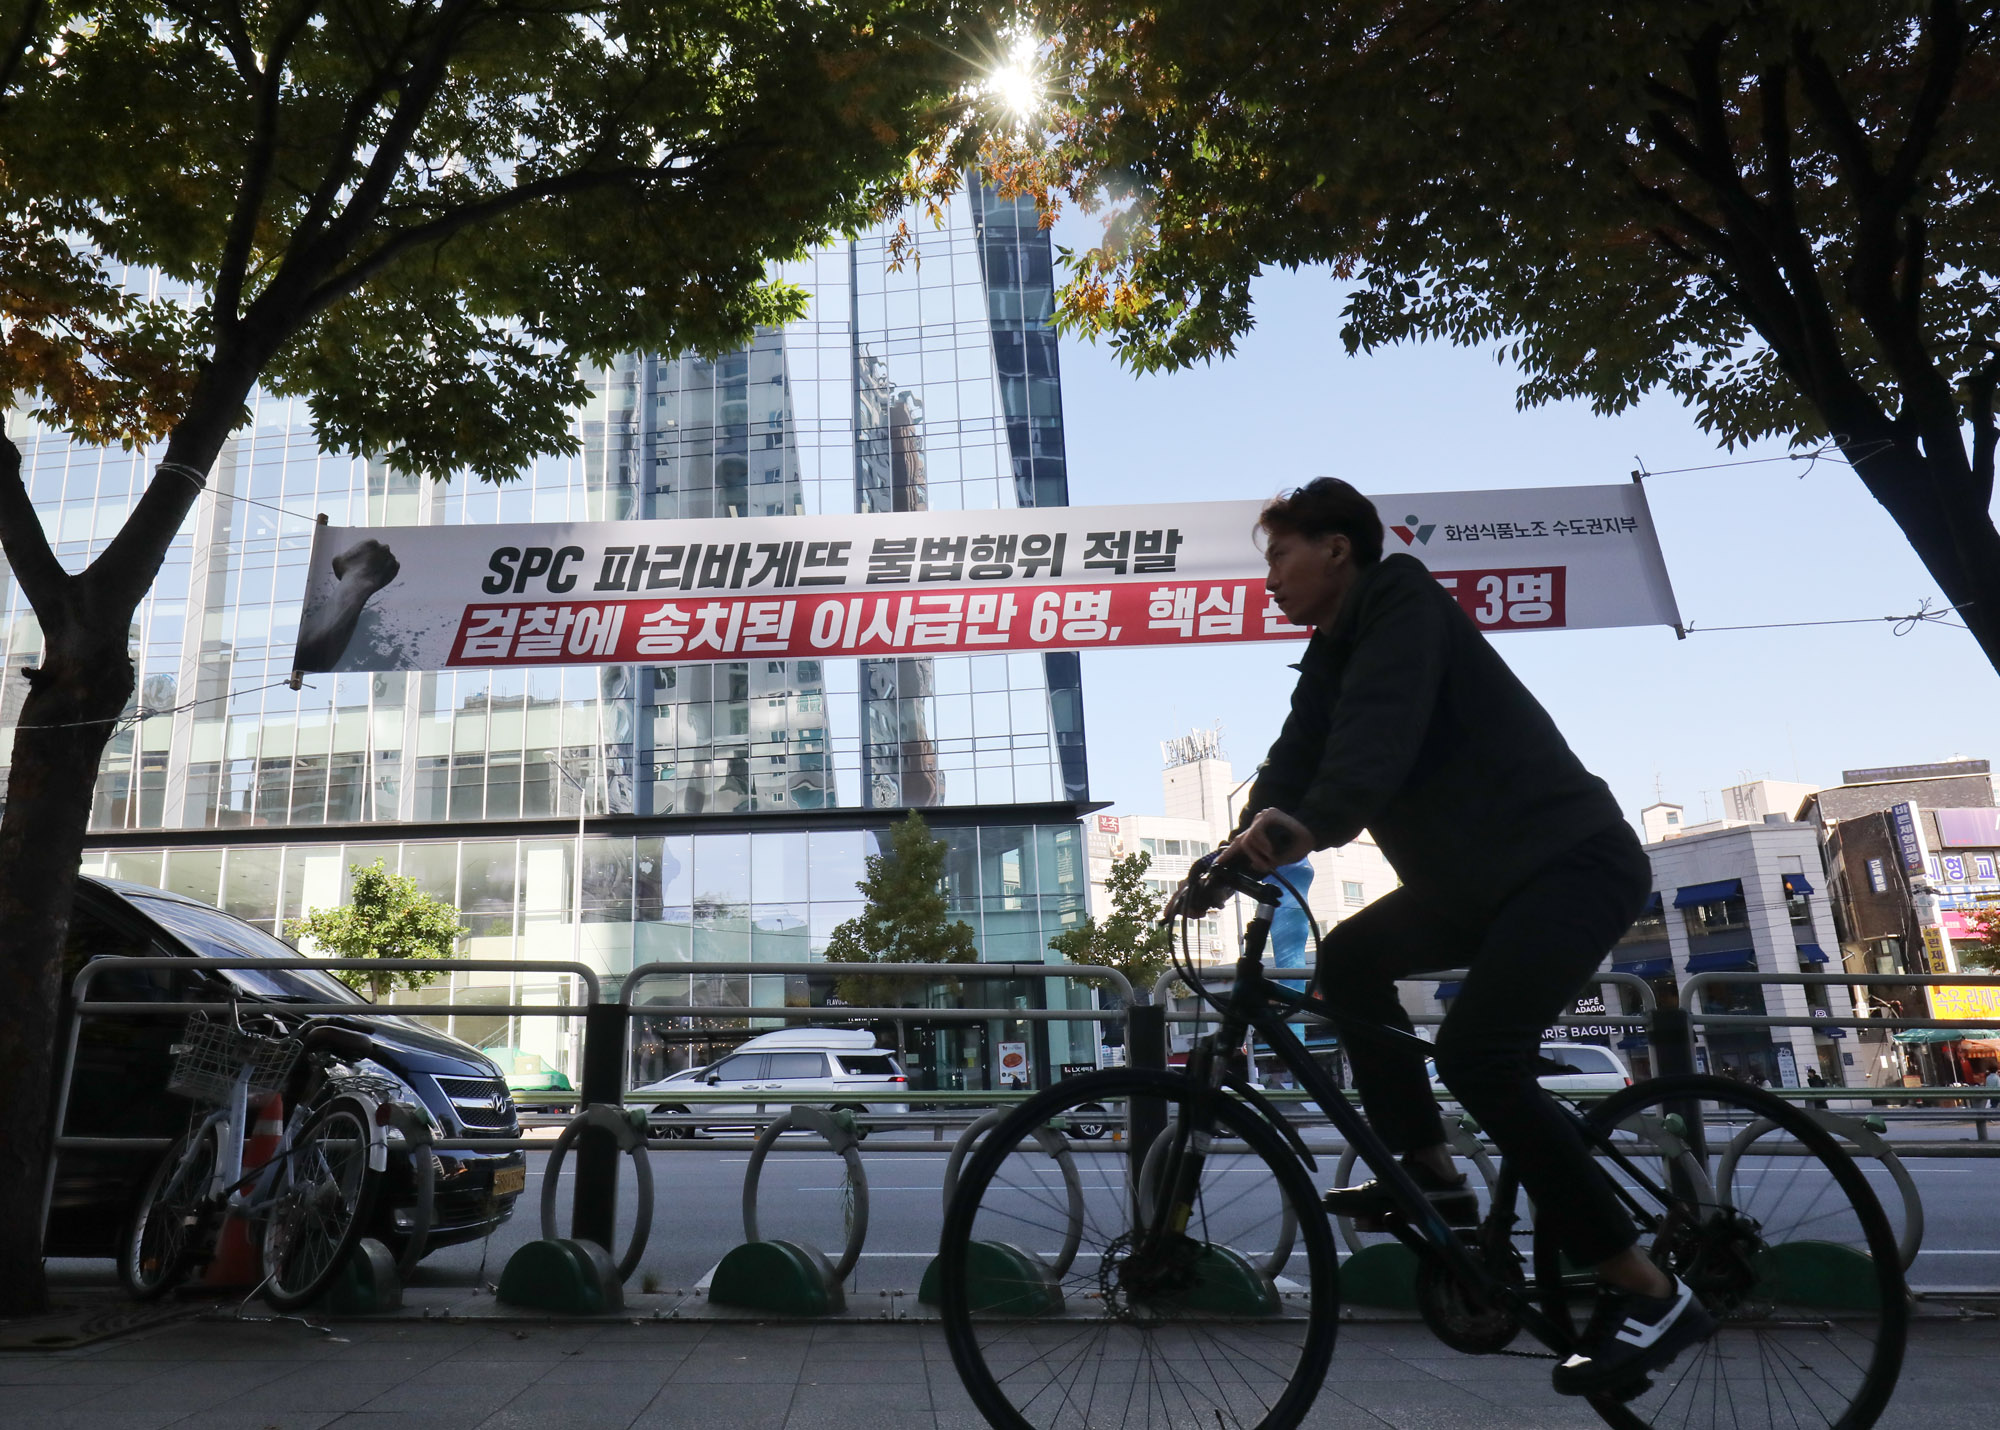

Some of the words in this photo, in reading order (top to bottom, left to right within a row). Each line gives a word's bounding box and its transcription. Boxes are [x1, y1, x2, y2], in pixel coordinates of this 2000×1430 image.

[1444, 520, 1549, 542] 화섬식품노조
[1553, 516, 1639, 538] 수도권지부
[480, 545, 585, 594] SPC
[593, 540, 851, 592] 파리바게뜨
[866, 531, 1067, 585] 불법행위
[1082, 527, 1183, 573] 적발
[461, 604, 628, 659] 검찰에
[637, 600, 796, 655] 송치된
[809, 592, 1017, 652] 이사급만
[1028, 588, 1124, 643] 6명,
[1147, 585, 1245, 636] 핵심
[1475, 572, 1553, 624] 3명
[1928, 938, 1945, 972] 란제리
[1575, 1004, 1606, 1014] ADAGIO
[1577, 996, 1600, 1007] CAFÉ
